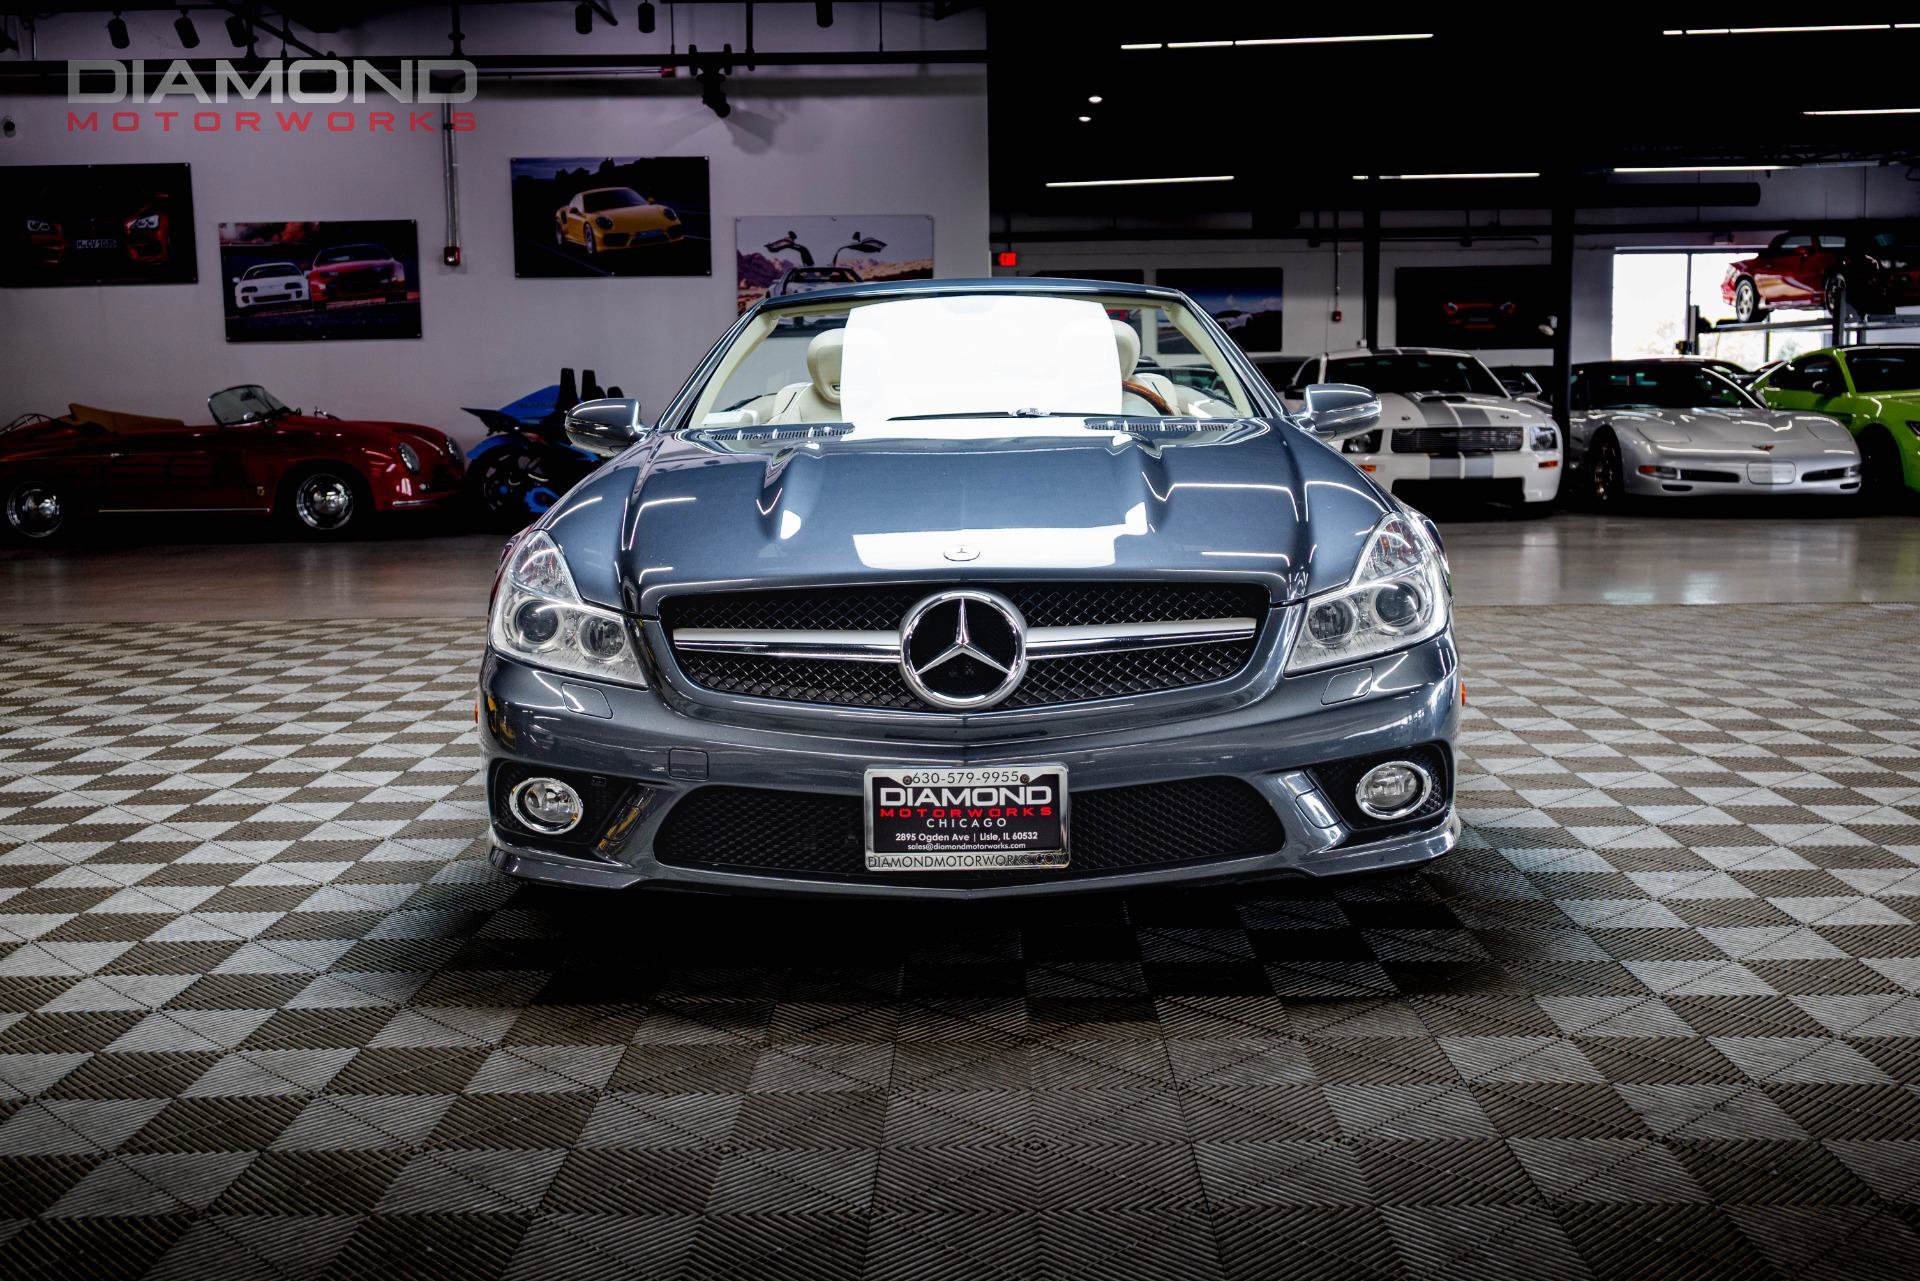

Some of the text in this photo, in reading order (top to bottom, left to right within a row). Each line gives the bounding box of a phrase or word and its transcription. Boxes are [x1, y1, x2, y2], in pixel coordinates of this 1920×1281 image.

[912, 771, 1019, 784] 630-579-9955
[880, 786, 1052, 807] DIAMOND
[880, 807, 1052, 817] MOTORWORKS
[926, 818, 1007, 828] CHICAGO
[895, 833, 917, 841] 2895
[918, 833, 950, 843] Ogden
[951, 833, 970, 841] Ave
[980, 833, 1001, 842] Lisle,
[1003, 832, 1010, 841] IL
[1012, 832, 1038, 840] 60532
[907, 842, 1026, 851] sales@diamondmotorworks.com
